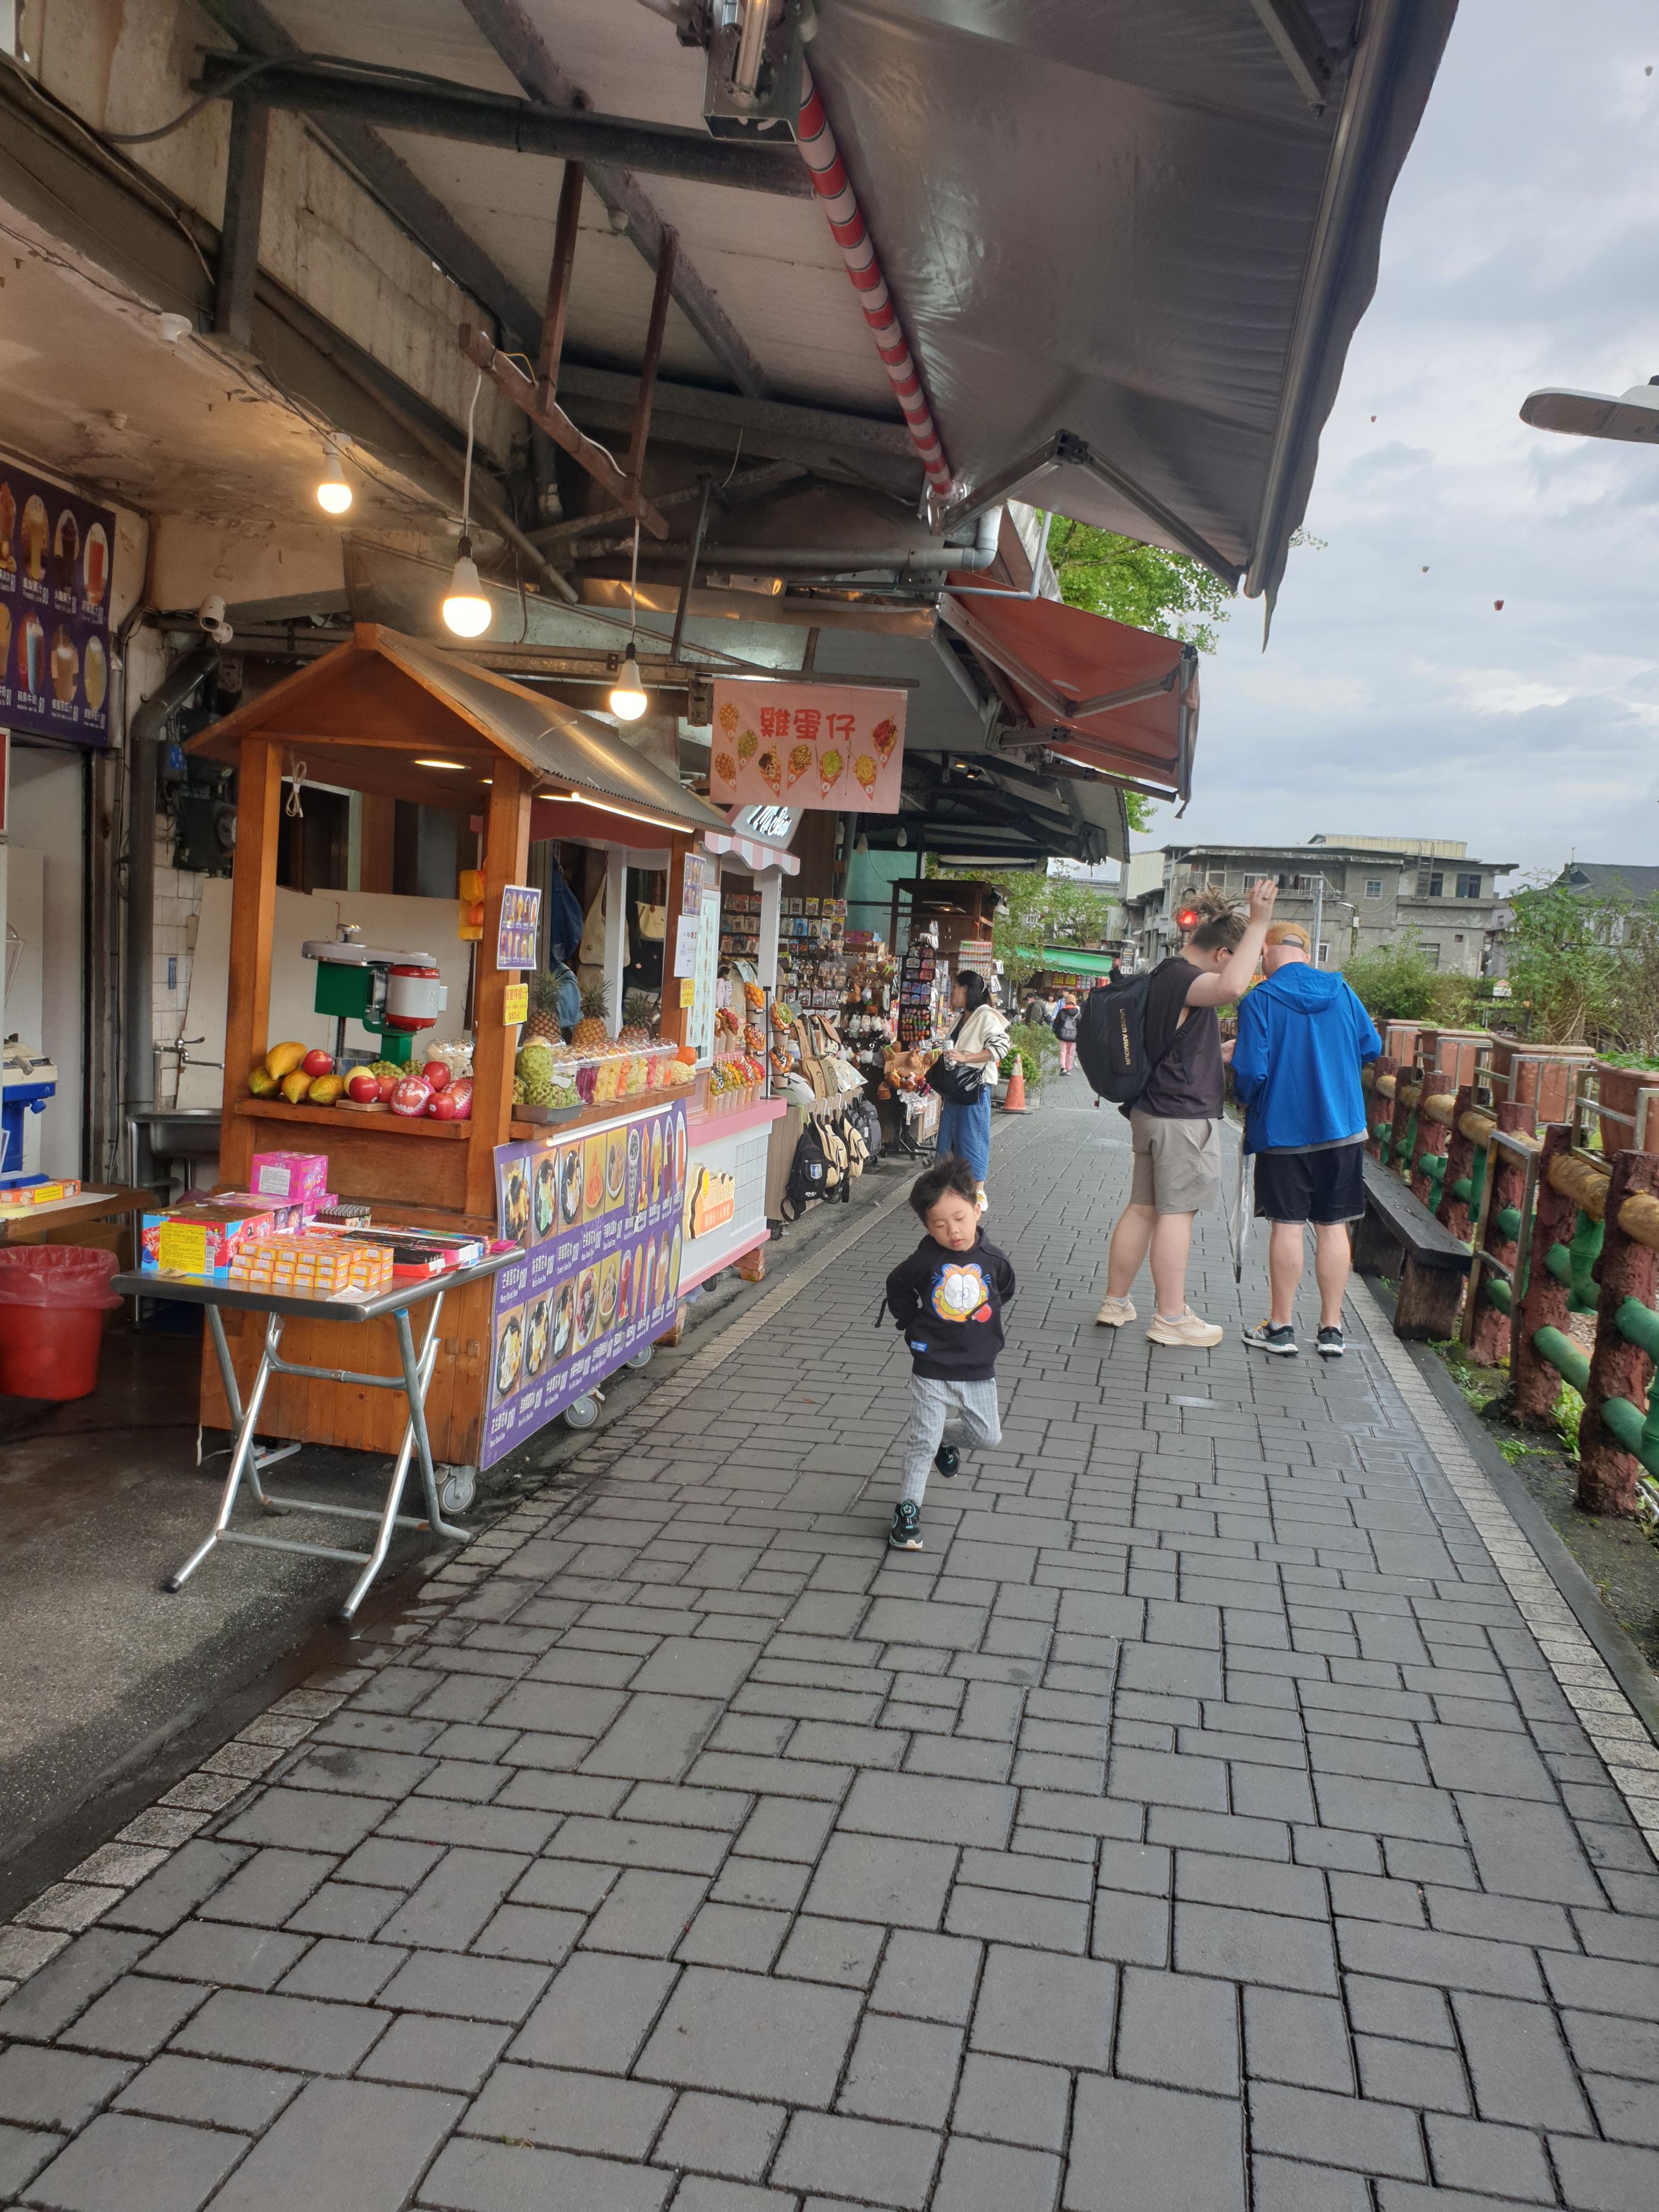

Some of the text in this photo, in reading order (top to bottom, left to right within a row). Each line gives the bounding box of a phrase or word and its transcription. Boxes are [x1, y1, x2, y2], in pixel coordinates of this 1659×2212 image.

[39, 697, 45, 714] 80
[760, 707, 856, 741] 雞蛋仔
[1122, 1034, 1131, 1065] ARMOUR
